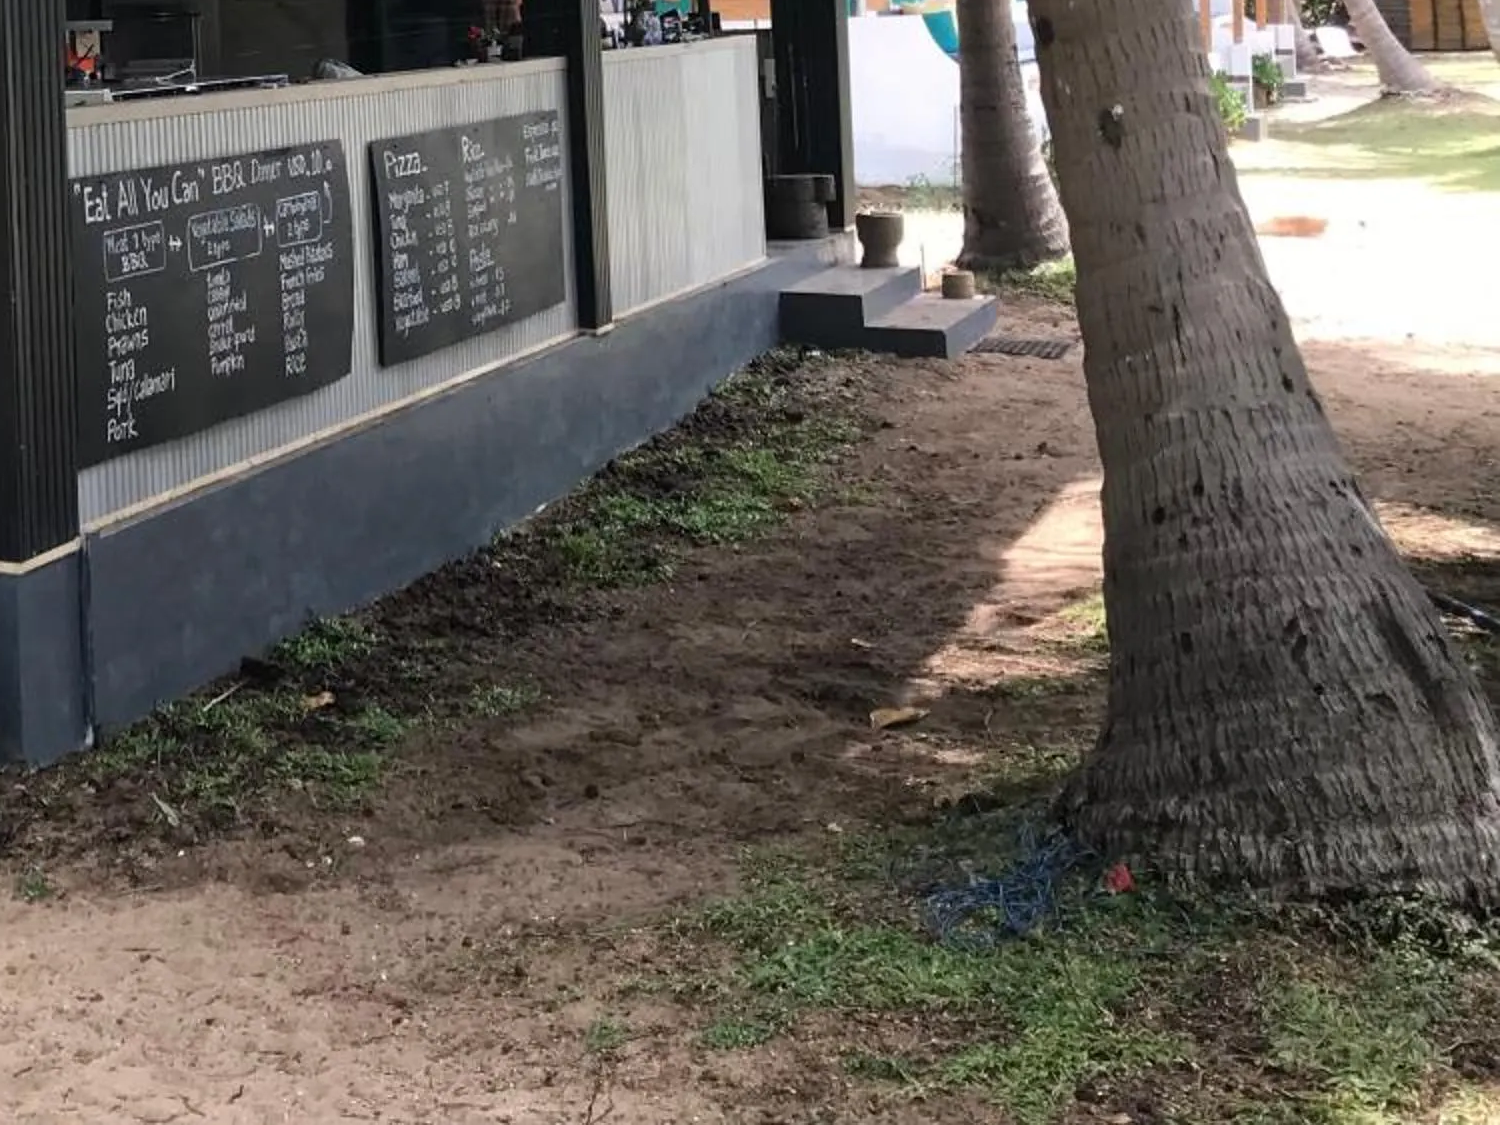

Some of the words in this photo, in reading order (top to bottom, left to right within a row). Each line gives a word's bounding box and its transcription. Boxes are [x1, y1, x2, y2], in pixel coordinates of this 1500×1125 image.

[117, 180, 139, 217] All
[144, 180, 169, 211] You
[212, 160, 246, 195] BBQ
[107, 289, 132, 311] Fish
[106, 307, 147, 333] Chicken
